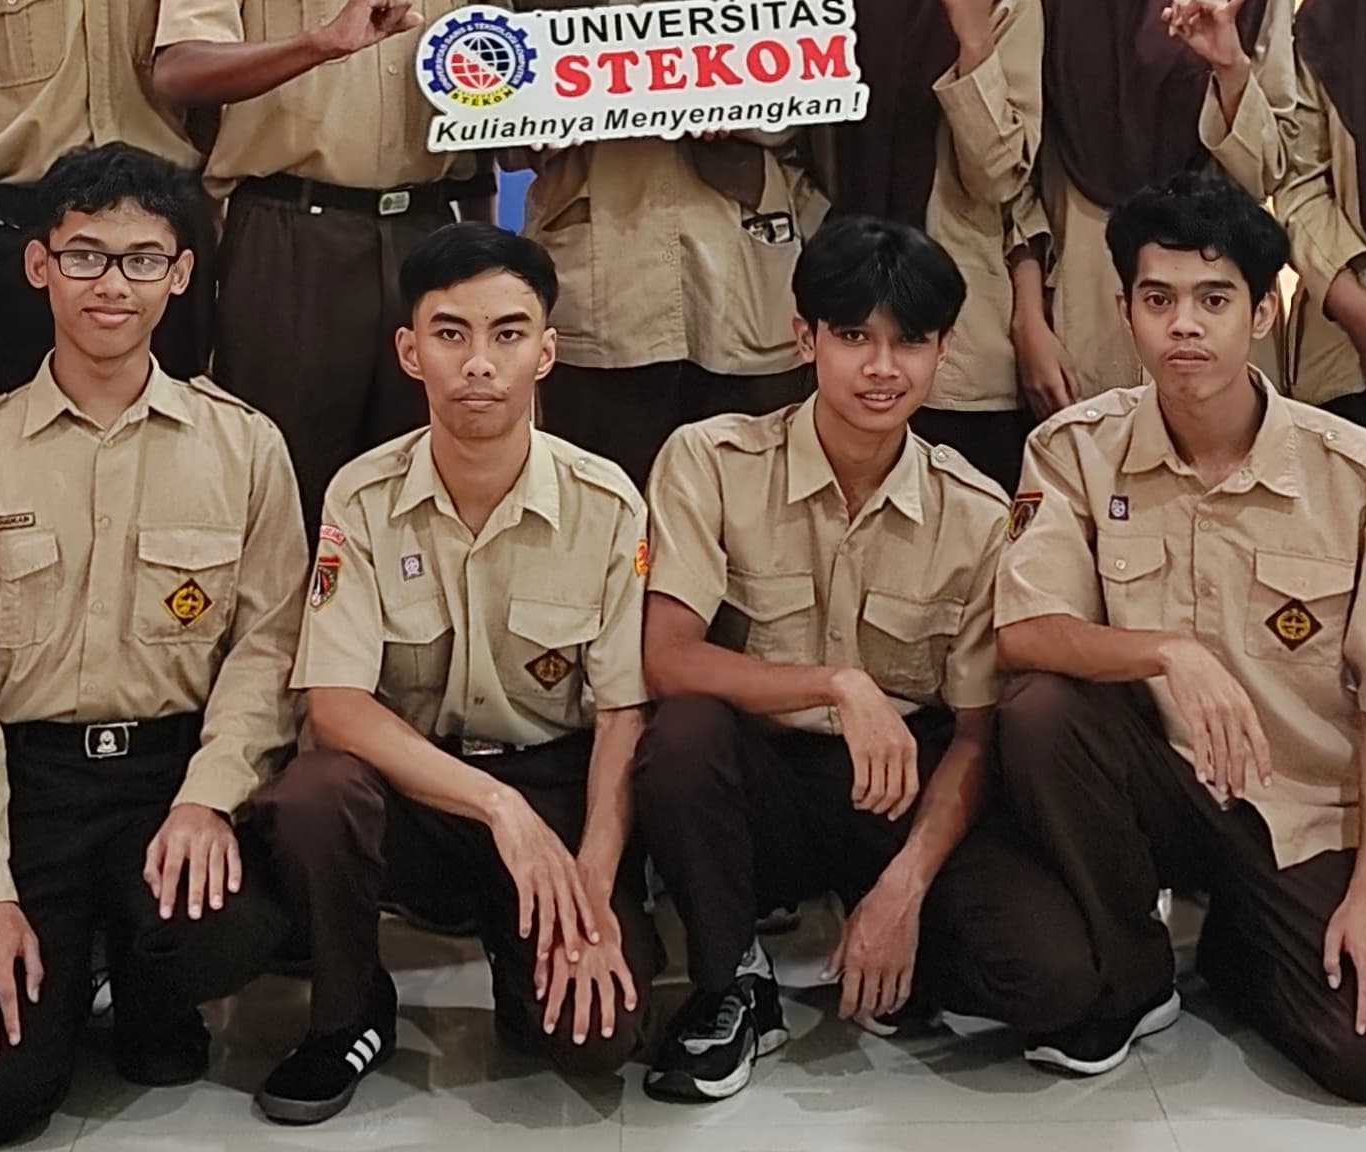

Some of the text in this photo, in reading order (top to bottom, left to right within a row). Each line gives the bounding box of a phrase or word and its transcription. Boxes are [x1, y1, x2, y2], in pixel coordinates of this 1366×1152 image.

[554, 34, 853, 99] STEKOM
[436, 114, 594, 144] Kuliahnya
[604, 96, 842, 132] Menyenangkan
